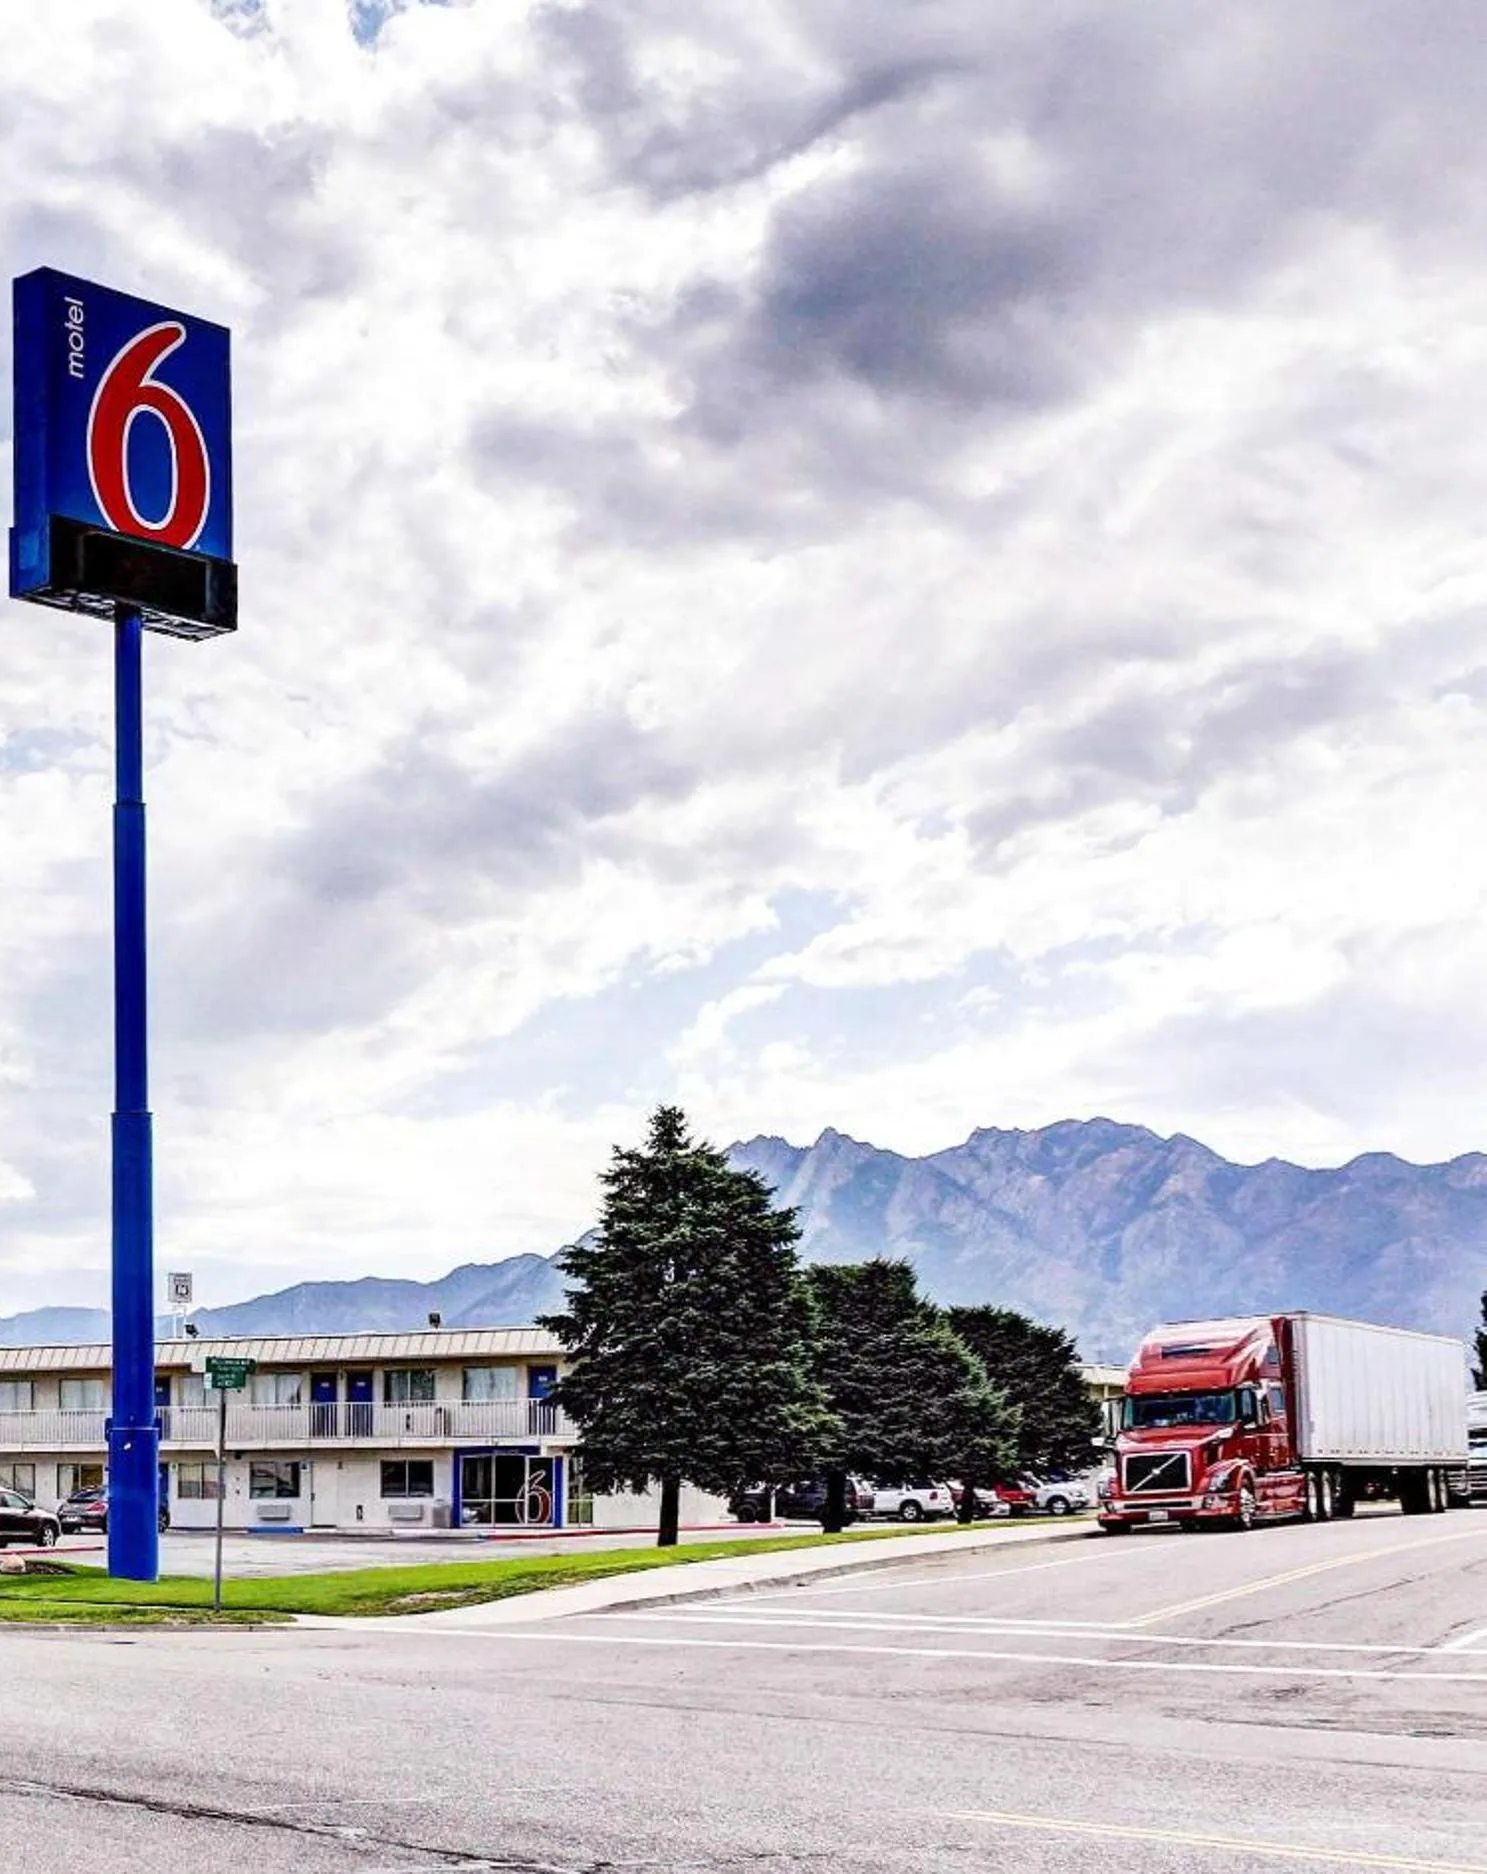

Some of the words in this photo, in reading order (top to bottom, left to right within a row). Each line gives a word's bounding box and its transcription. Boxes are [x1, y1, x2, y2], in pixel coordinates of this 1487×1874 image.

[64, 296, 84, 379] motel
[86, 321, 211, 550] 6
[515, 1469, 552, 1524] 6
